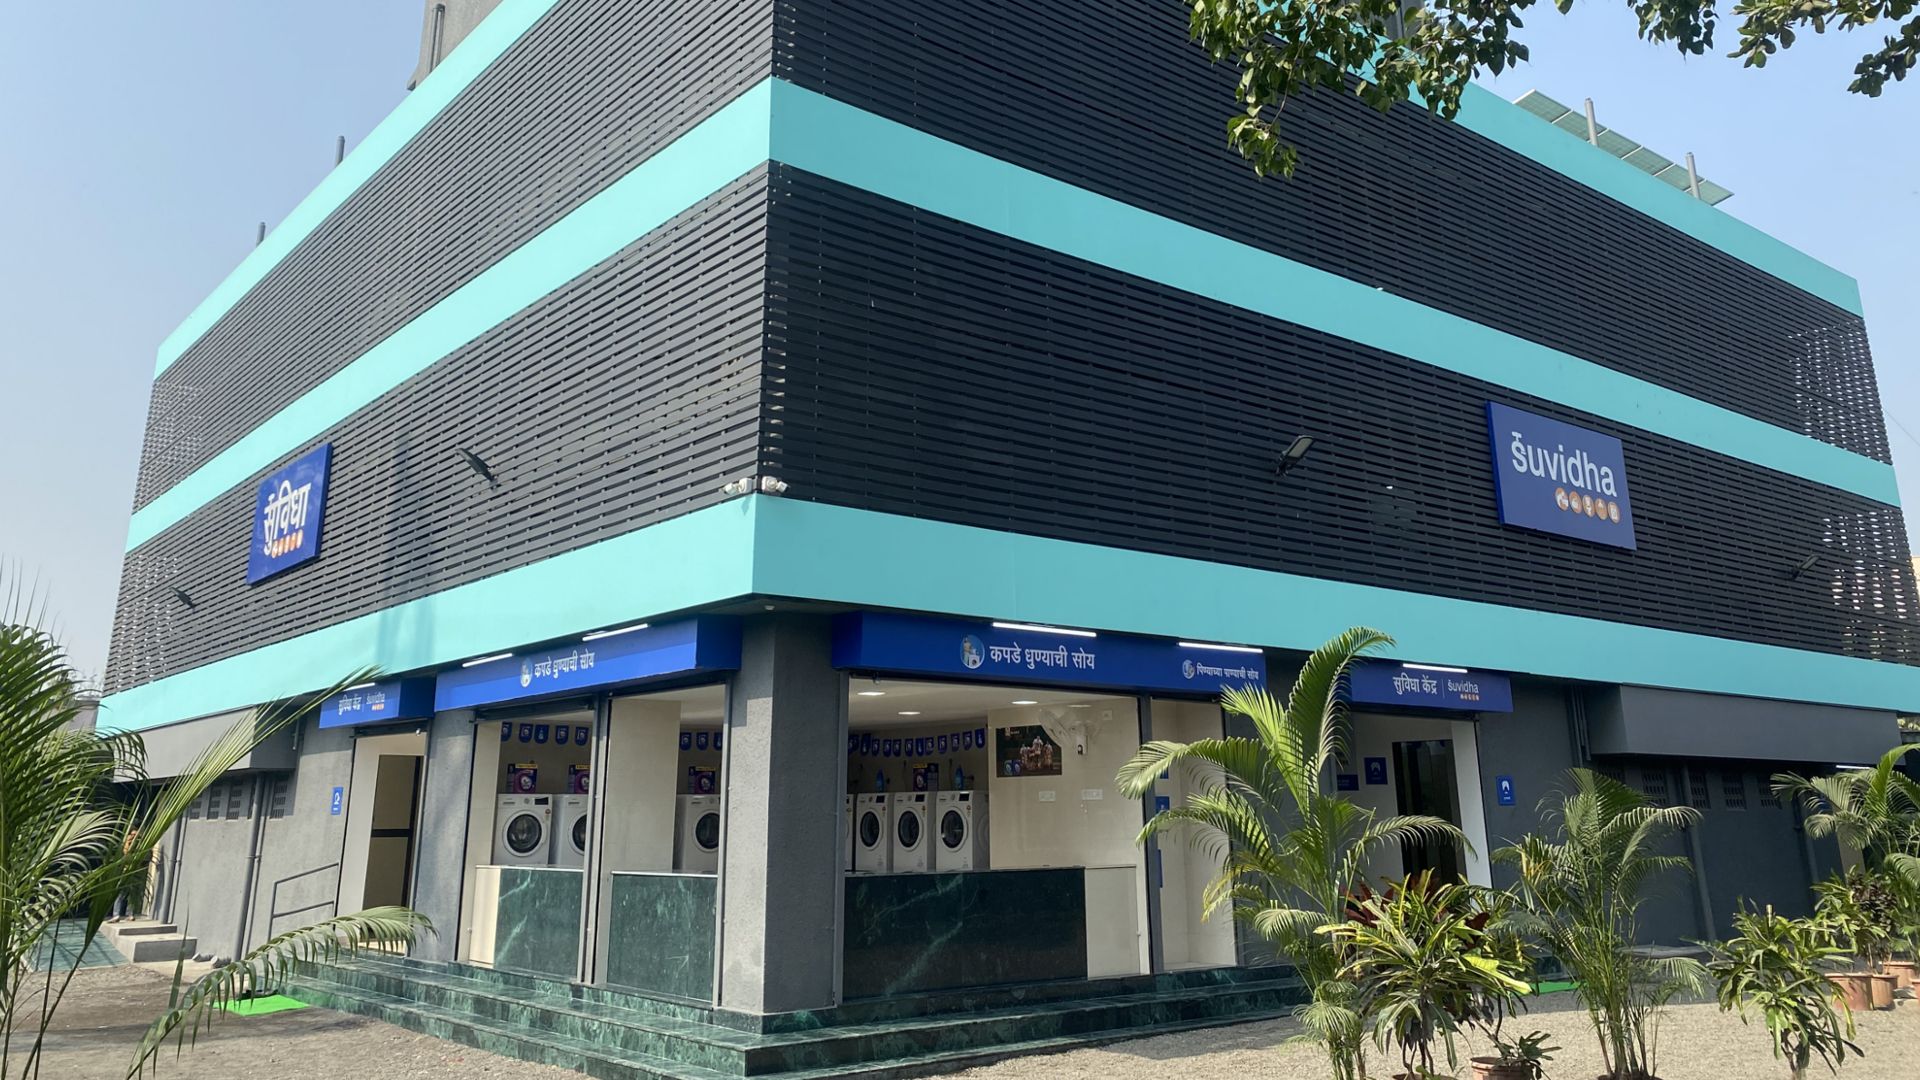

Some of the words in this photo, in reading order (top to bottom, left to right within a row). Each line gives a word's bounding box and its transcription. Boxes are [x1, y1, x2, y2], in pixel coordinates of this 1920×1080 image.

[534, 656, 552, 678] कपडे
[580, 648, 595, 670] सोय
[989, 642, 1021, 664] कपडे
[1025, 645, 1068, 670] धुण्याची
[1071, 648, 1095, 670] सोय
[1392, 672, 1420, 695] सुविधा
